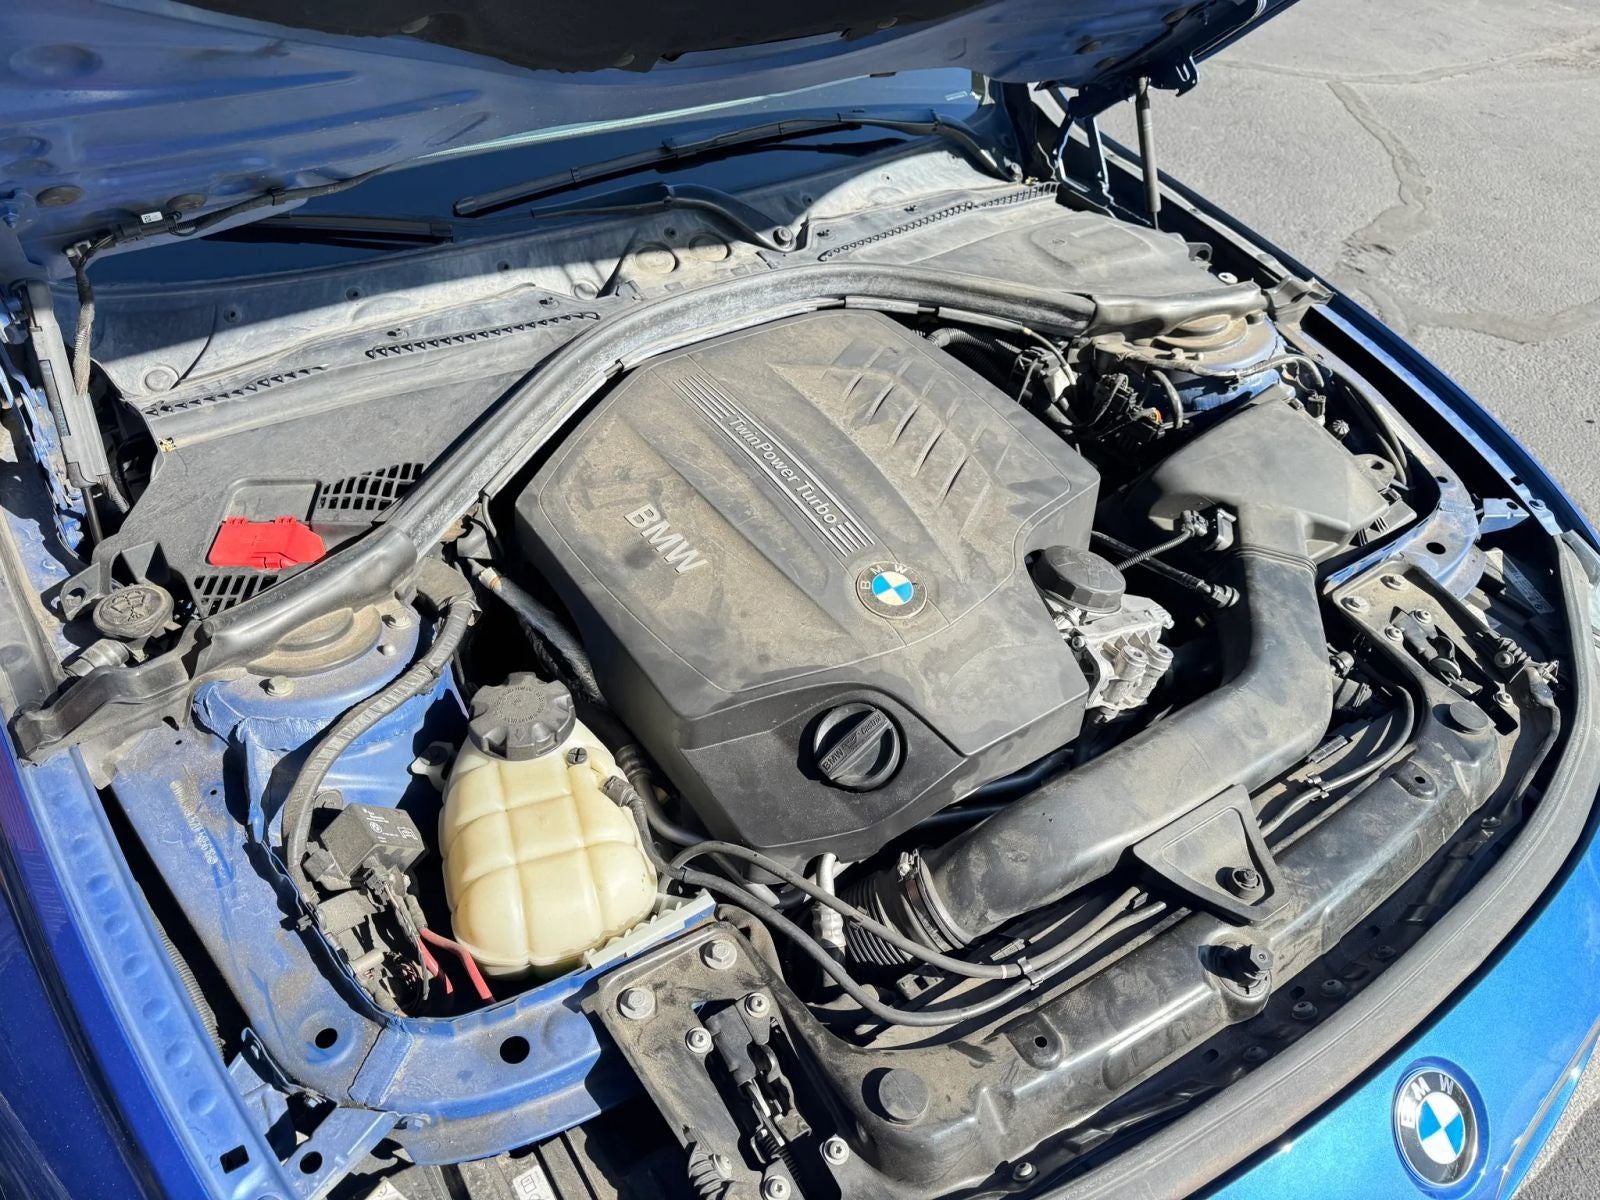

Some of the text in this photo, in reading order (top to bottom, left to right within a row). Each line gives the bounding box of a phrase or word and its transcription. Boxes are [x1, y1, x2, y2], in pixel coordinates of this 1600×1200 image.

[727, 416, 837, 525] TwinPower Turbo
[624, 503, 708, 574] BMW
[860, 564, 907, 590] BMW
[823, 748, 844, 771] BMW
[1400, 1074, 1454, 1129] BMW
